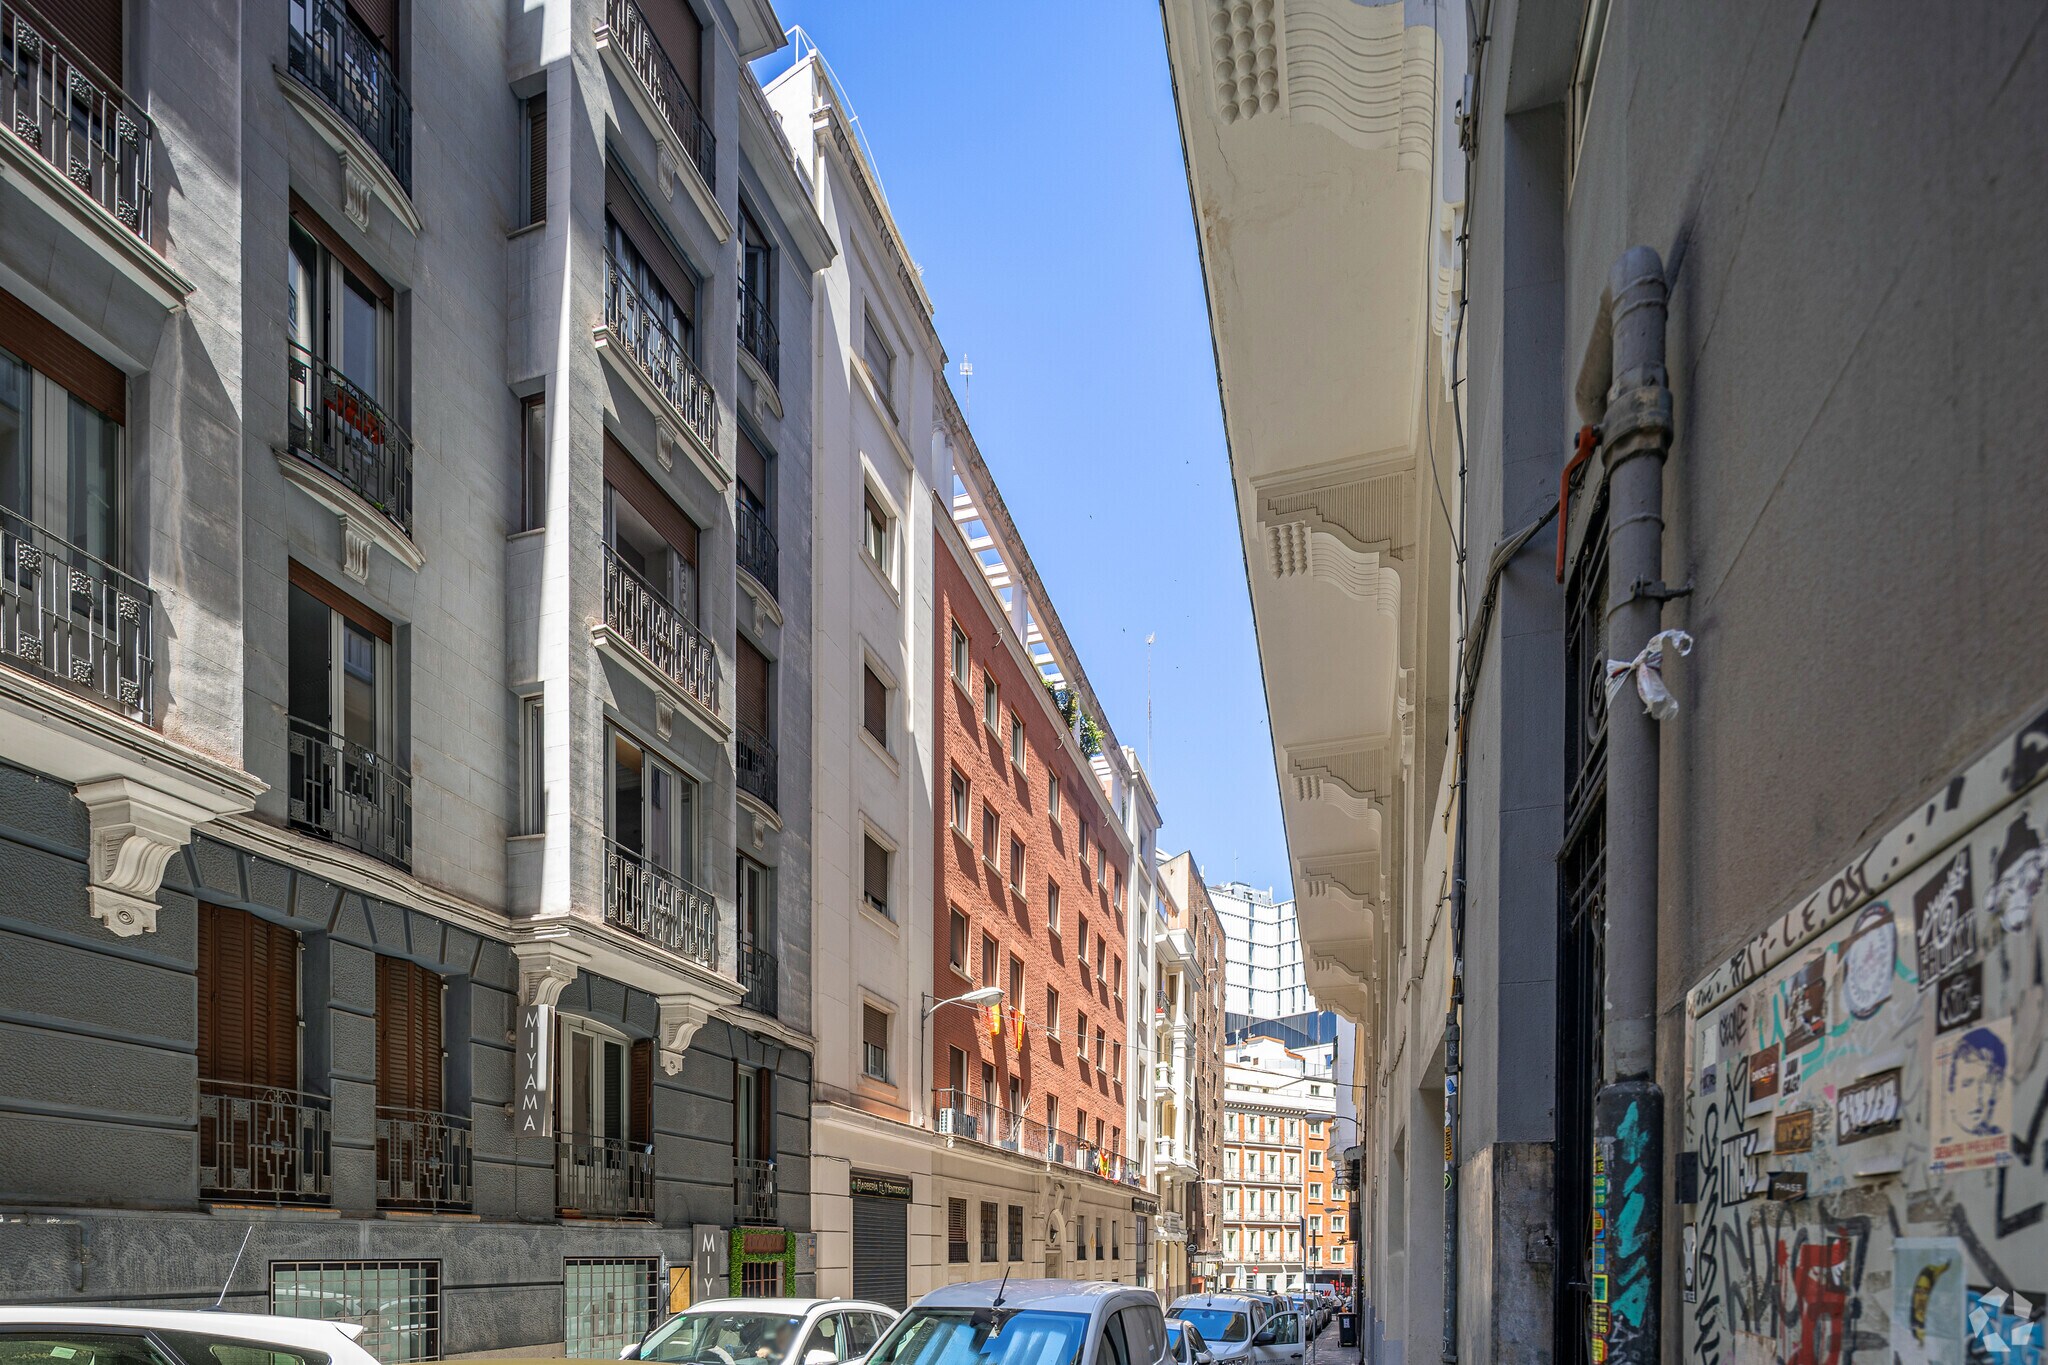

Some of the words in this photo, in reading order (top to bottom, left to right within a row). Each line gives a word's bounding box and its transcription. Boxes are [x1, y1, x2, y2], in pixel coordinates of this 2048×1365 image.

[522, 1011, 541, 1131] MIYAMA
[1774, 1182, 1803, 1192] PHASE
[702, 1232, 716, 1297] MIY
